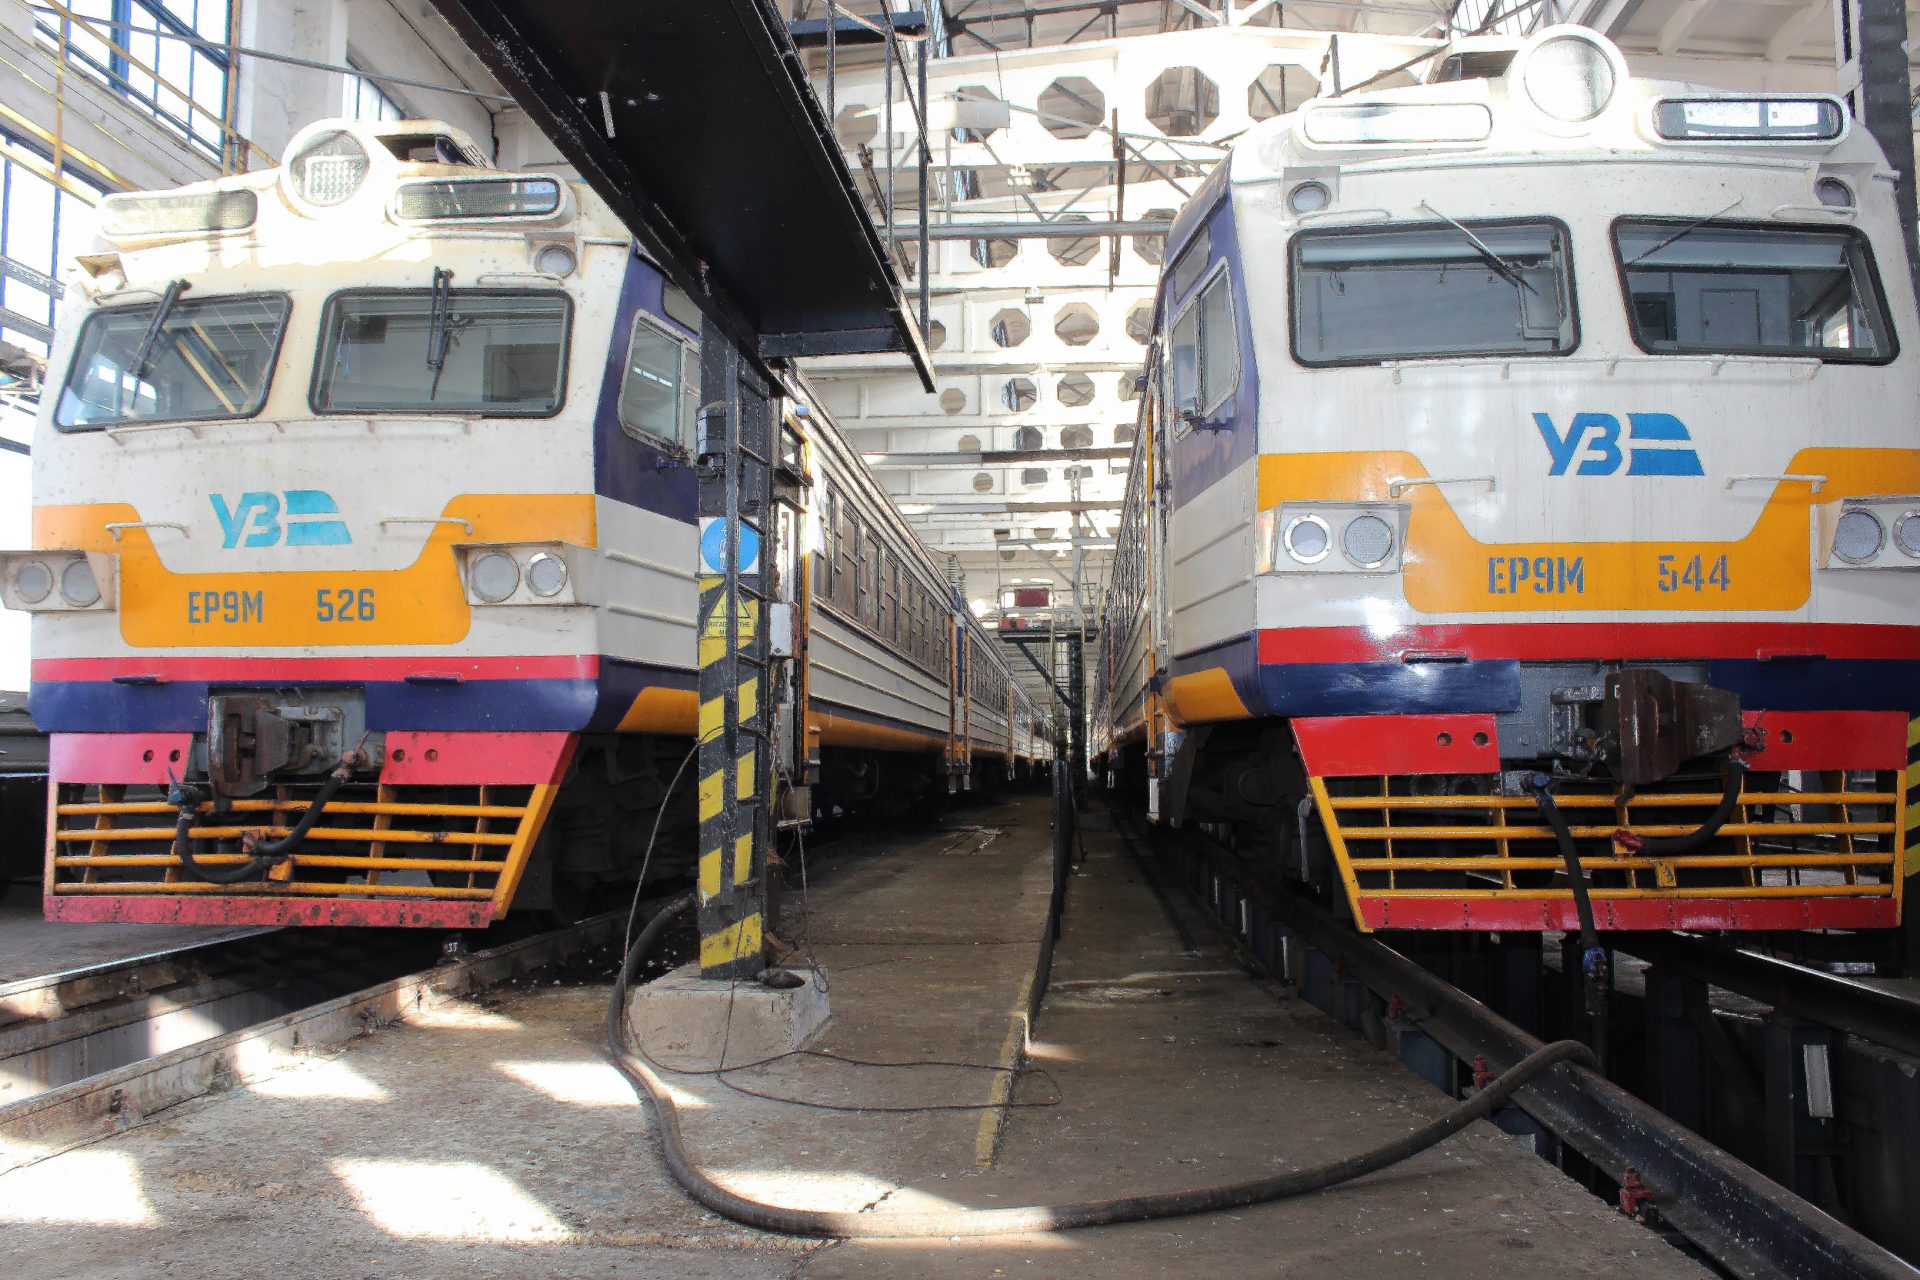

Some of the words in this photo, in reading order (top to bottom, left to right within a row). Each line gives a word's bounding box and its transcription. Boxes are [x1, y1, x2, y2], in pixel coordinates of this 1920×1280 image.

[1488, 556, 1585, 594] ЕР9М
[1658, 554, 1731, 592] 544
[188, 590, 263, 624] ЕР9М
[316, 588, 375, 622] 526
